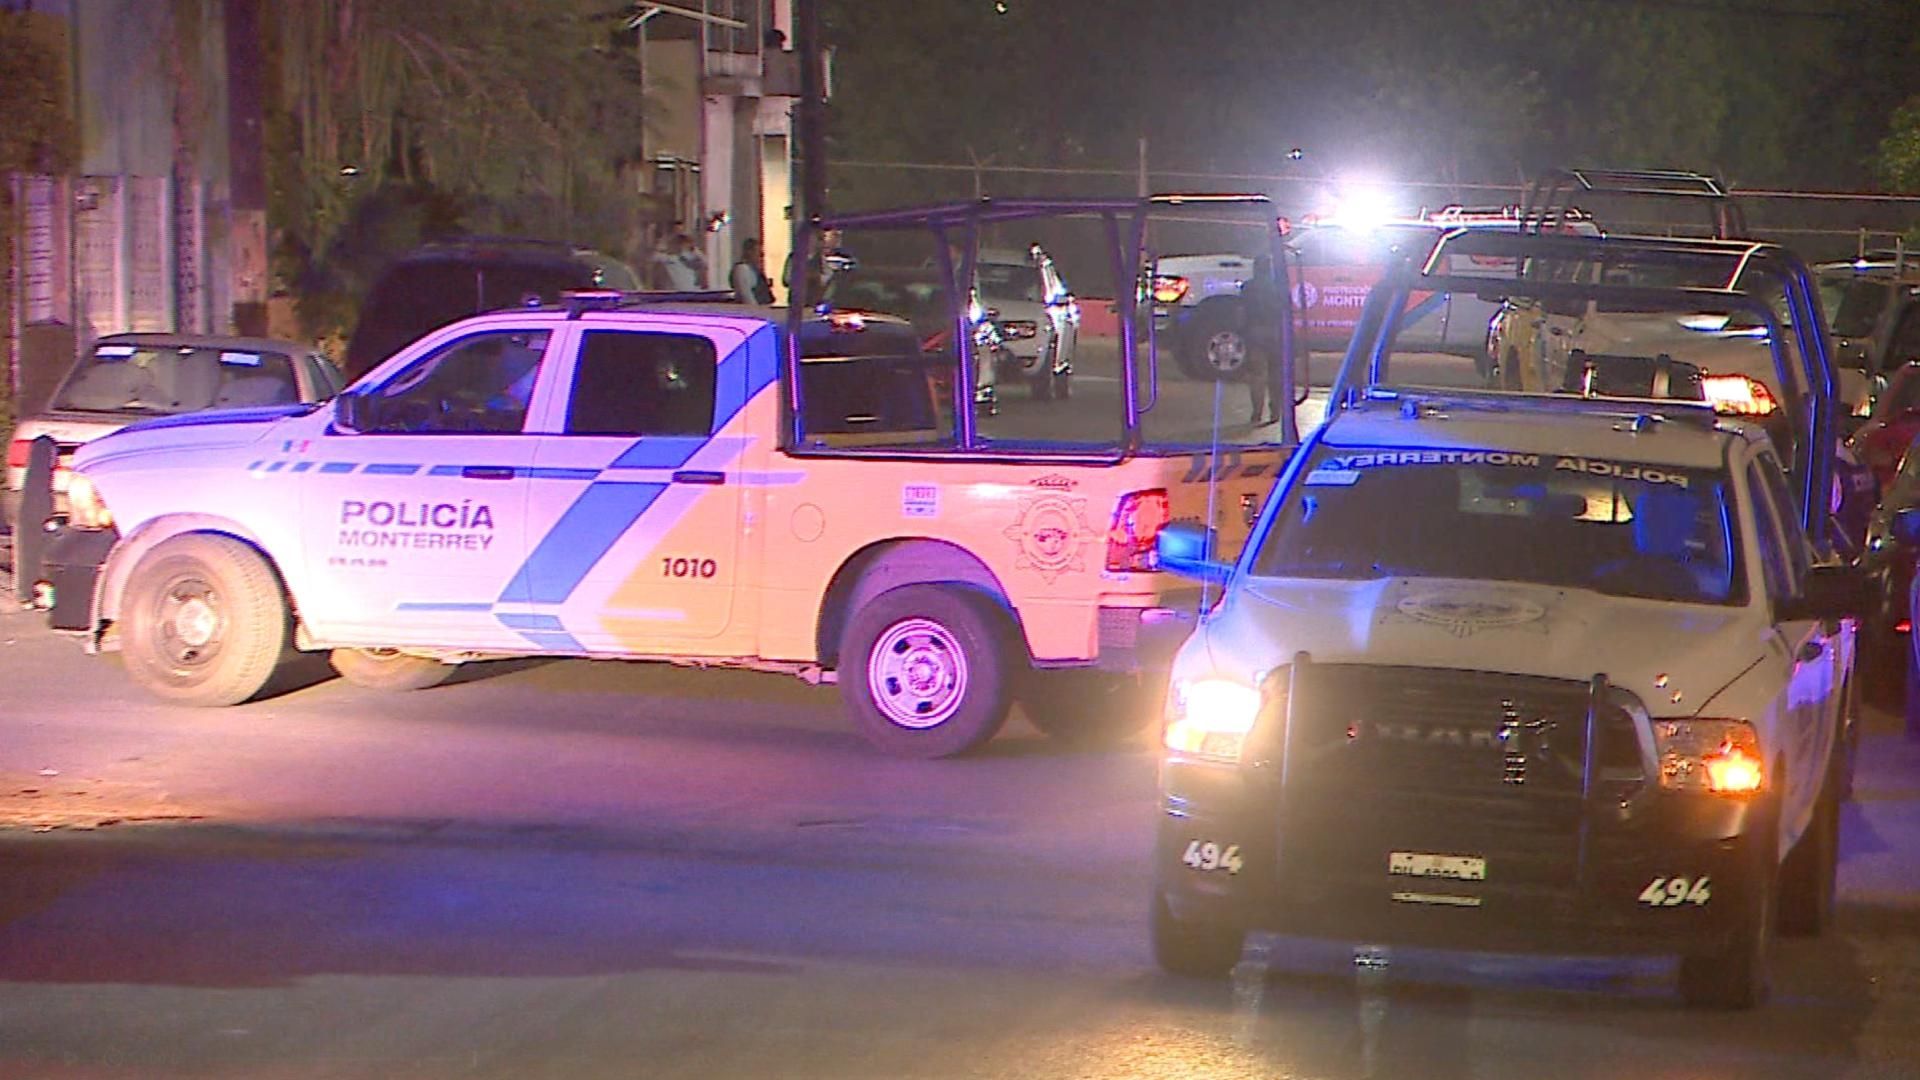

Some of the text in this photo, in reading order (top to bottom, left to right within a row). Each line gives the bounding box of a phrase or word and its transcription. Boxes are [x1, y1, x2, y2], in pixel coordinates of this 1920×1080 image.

[340, 498, 494, 529] POLICÍA
[338, 530, 494, 550] MONTERREY
[662, 557, 717, 578] 1010
[1183, 840, 1243, 873] 494
[1638, 876, 1711, 906] 494
